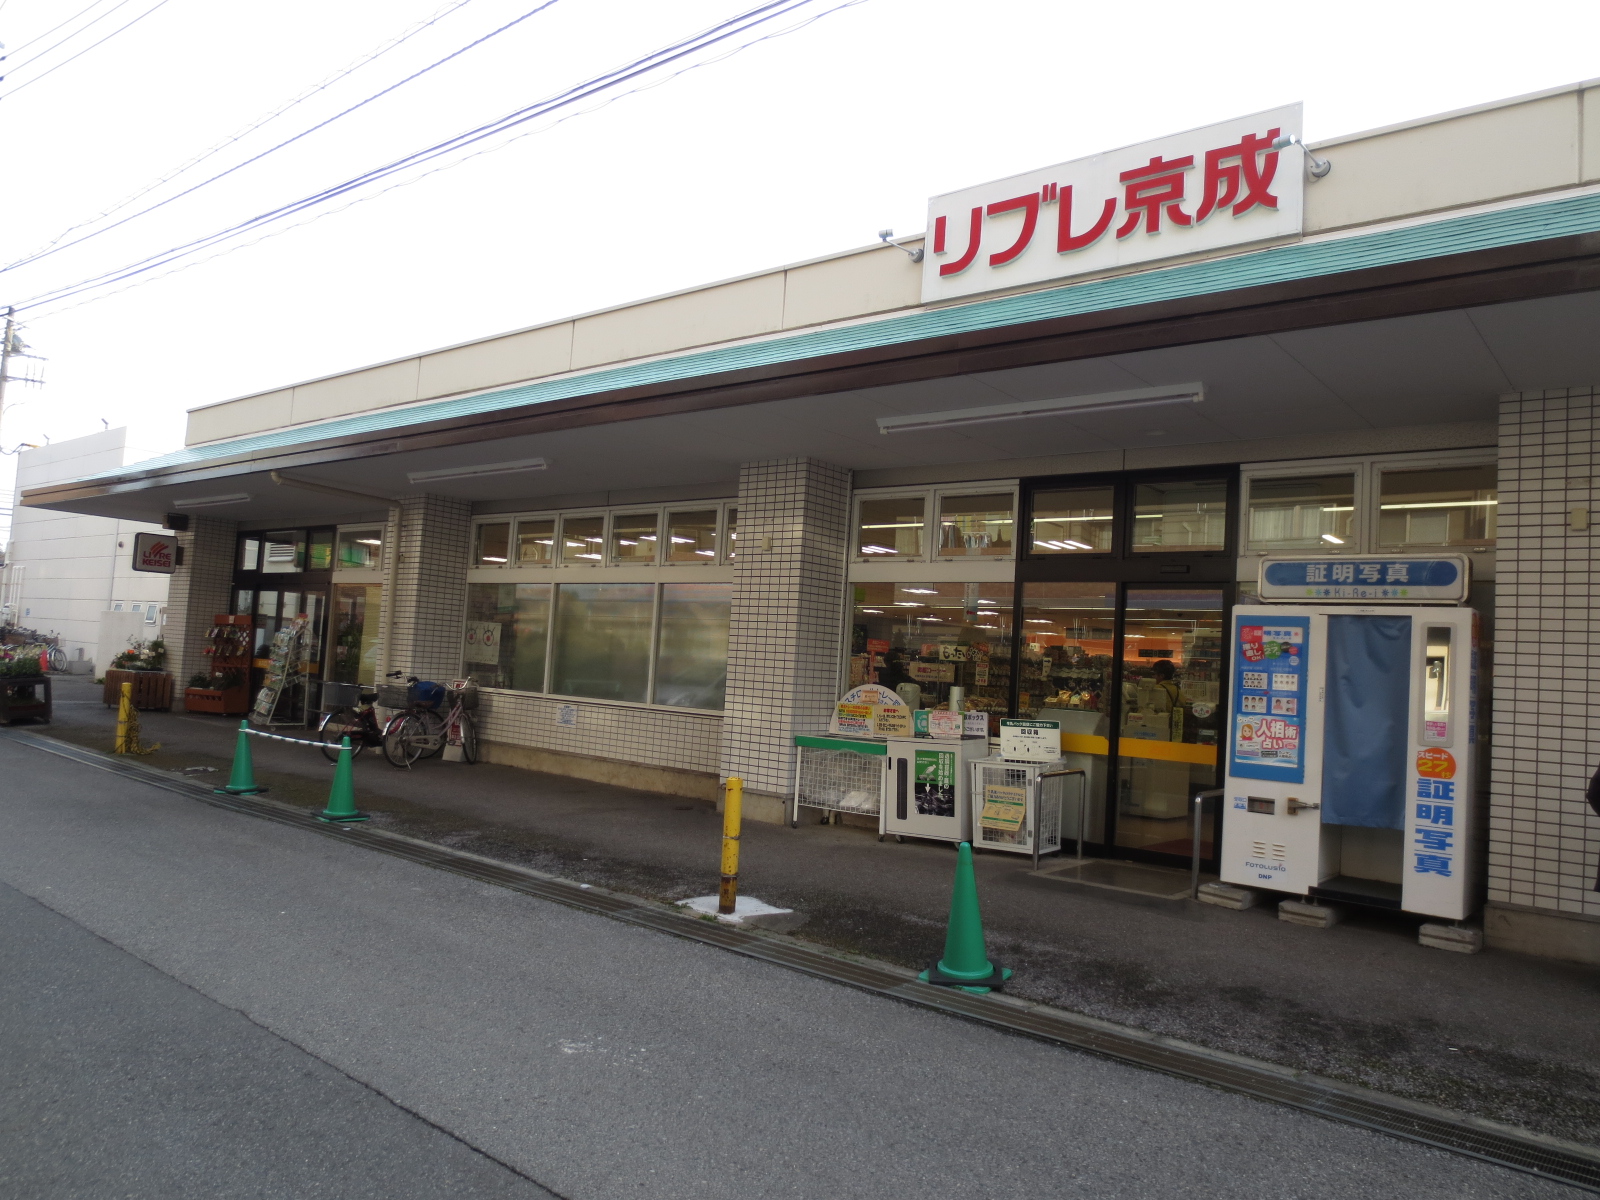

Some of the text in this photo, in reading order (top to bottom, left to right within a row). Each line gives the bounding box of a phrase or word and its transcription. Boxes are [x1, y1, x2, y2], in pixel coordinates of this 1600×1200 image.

[934, 127, 1281, 277] リブレ京成
[142, 559, 171, 567] KEISEI
[1306, 564, 1409, 583] 証明写真
[1334, 587, 1378, 598] Ki-Re-i
[1256, 719, 1297, 739] 人相術
[1261, 739, 1284, 750] 占い
[1416, 751, 1449, 760] スピード
[1414, 778, 1455, 877] 証明写真
